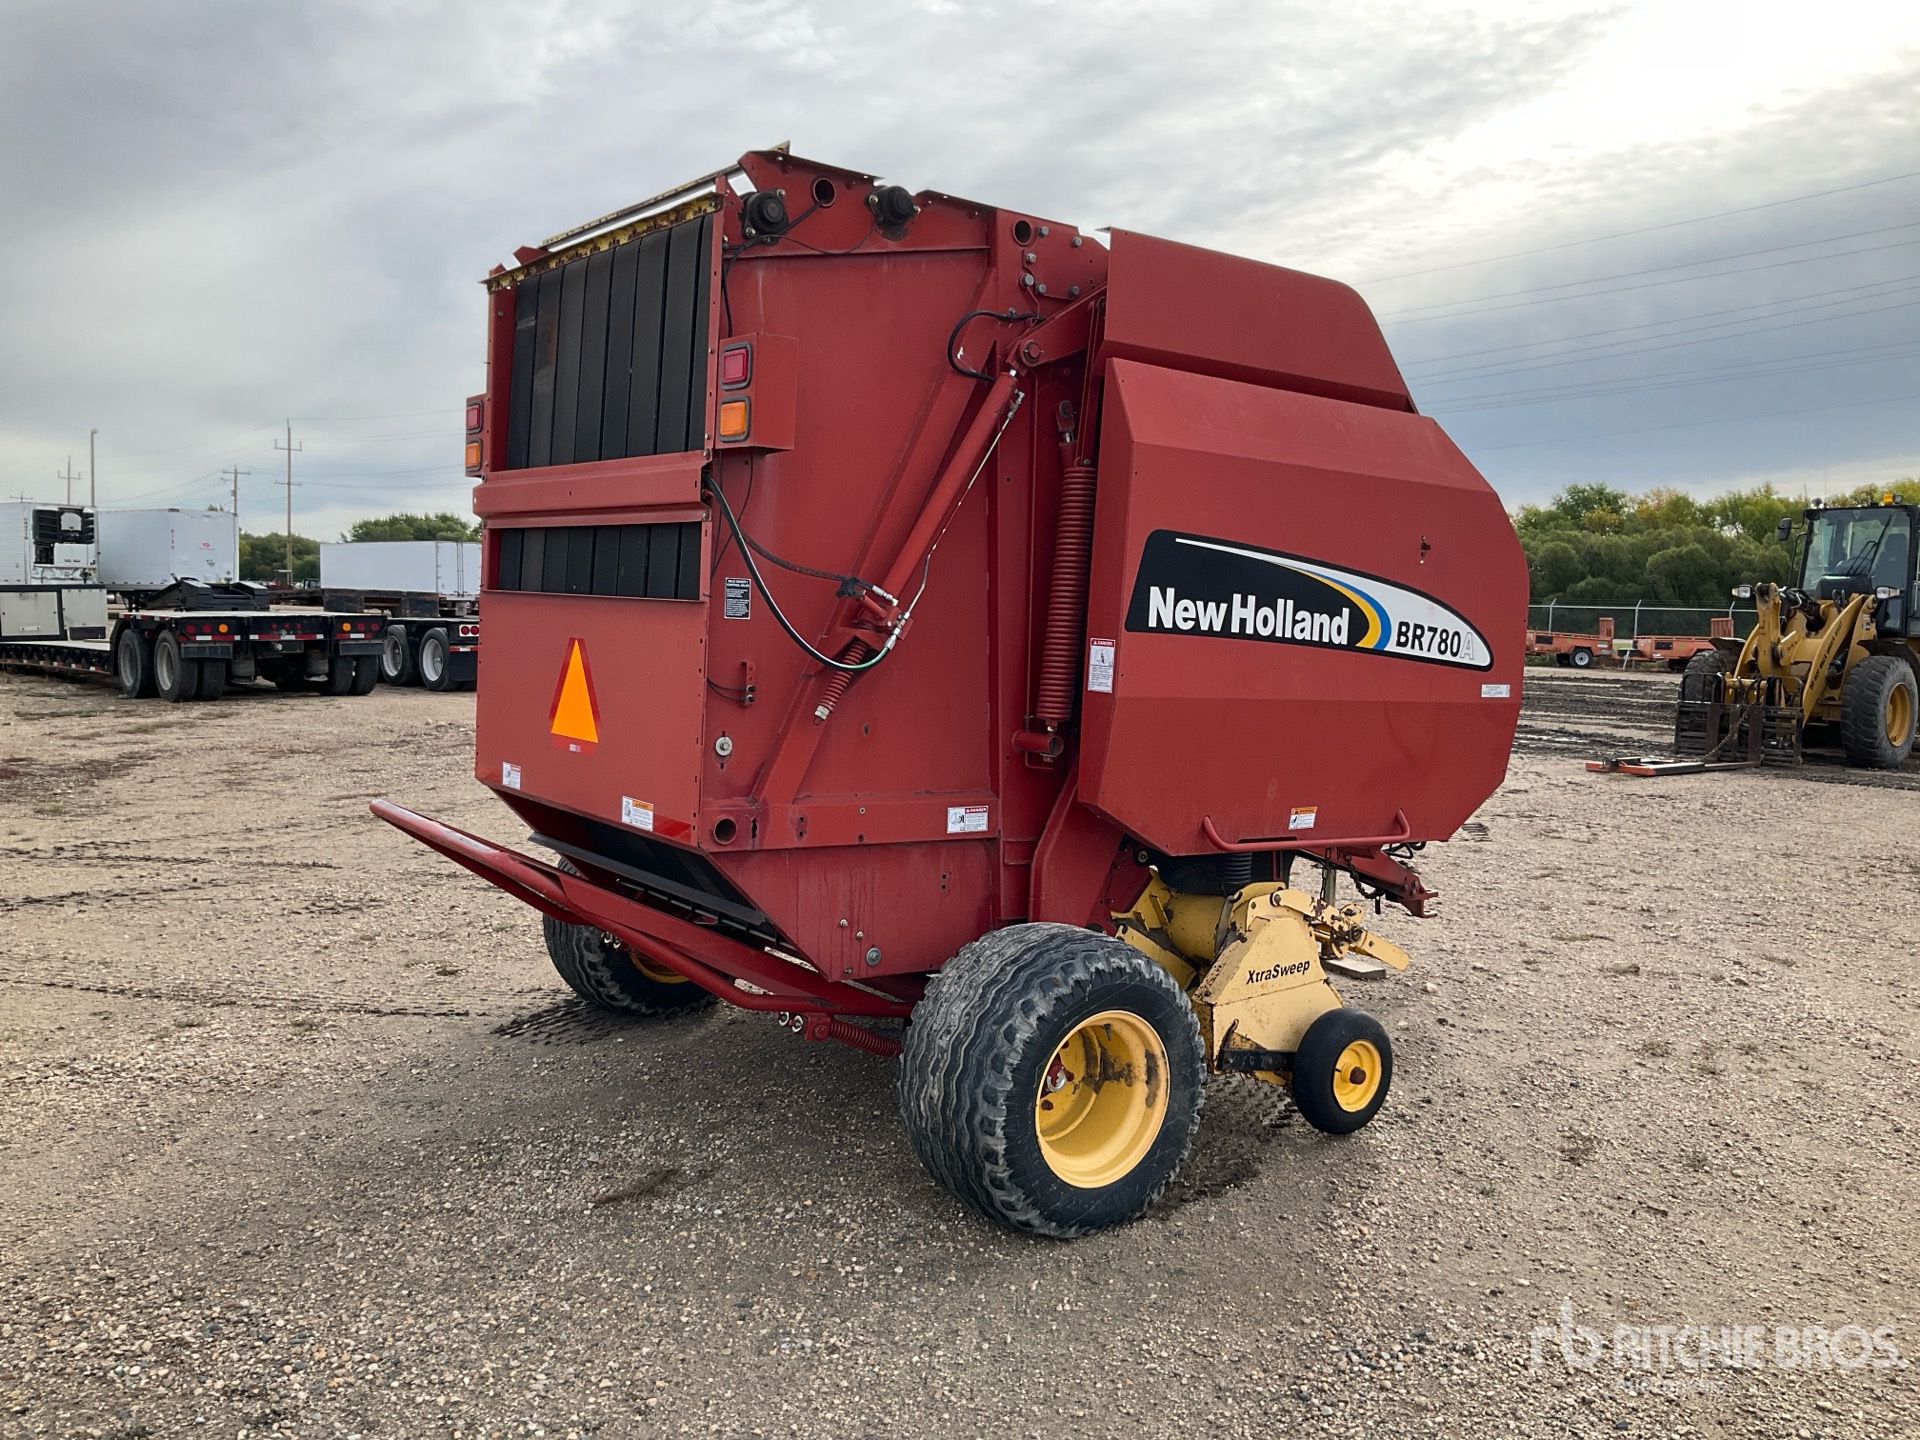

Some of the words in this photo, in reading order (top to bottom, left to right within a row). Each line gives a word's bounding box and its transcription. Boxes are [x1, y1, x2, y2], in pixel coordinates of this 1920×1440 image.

[1148, 586, 1228, 632] New
[1230, 593, 1350, 646] Holland
[1395, 621, 1475, 660] BR780A
[1245, 960, 1310, 985] XtraSweep
